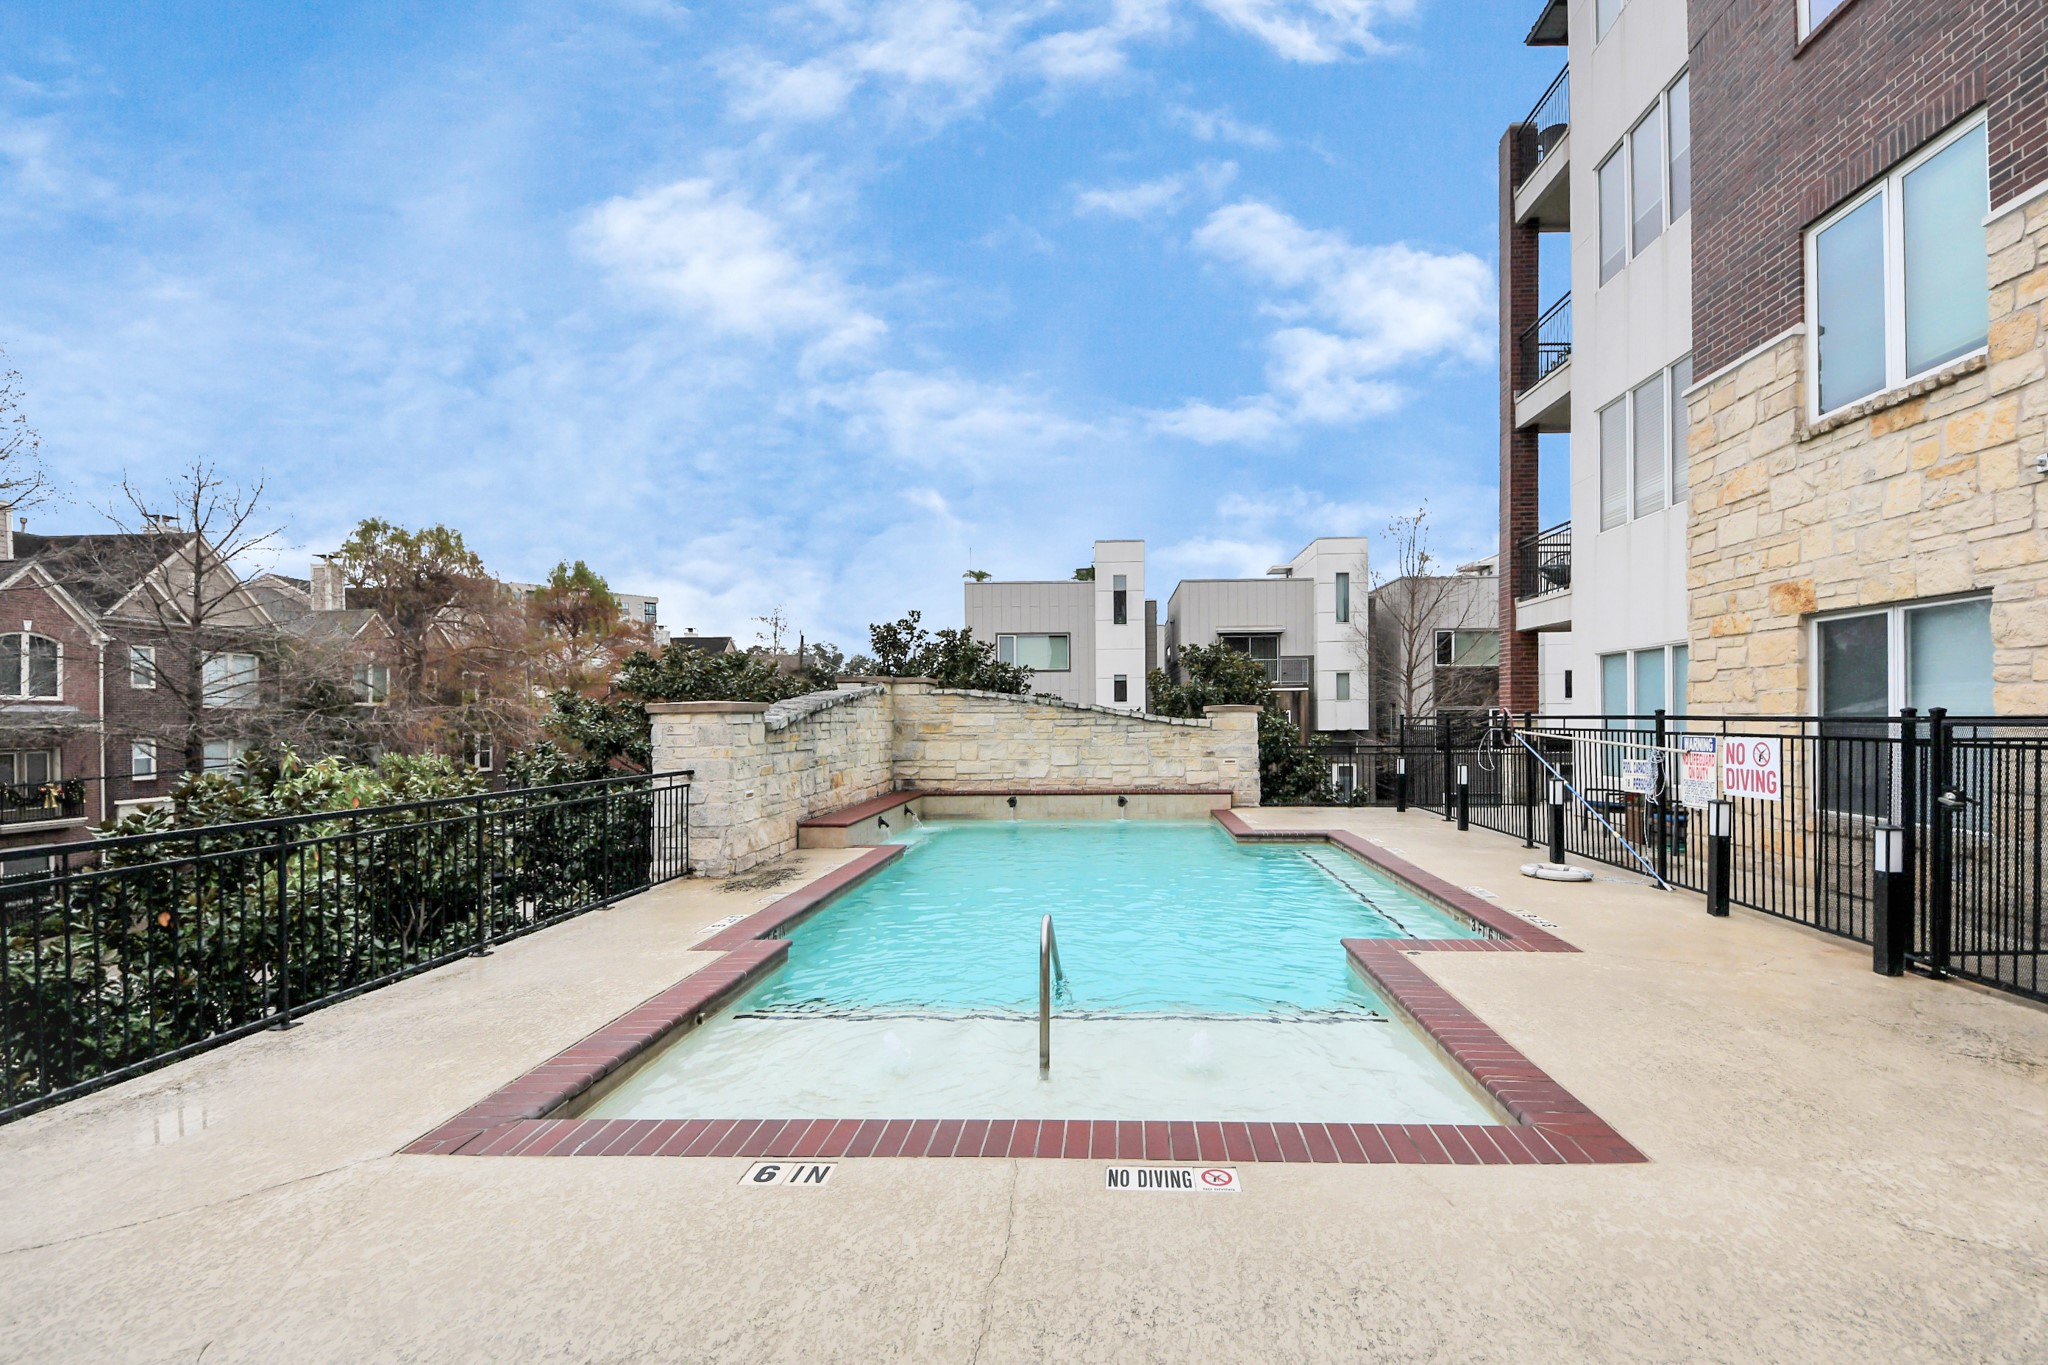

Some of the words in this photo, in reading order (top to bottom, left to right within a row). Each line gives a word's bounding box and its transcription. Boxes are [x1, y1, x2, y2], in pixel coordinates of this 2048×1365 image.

[1684, 738, 1713, 752] WARNING
[1690, 753, 1715, 767] LIFEGUARD
[1726, 742, 1745, 765] NO
[1696, 767, 1709, 780] DUTY
[1726, 767, 1777, 794] DIVING
[1471, 919, 1477, 932] 3
[753, 1165, 781, 1183] 6
[789, 1165, 831, 1184] IN
[1108, 1169, 1130, 1188] NO
[1138, 1169, 1193, 1188] DIVING
